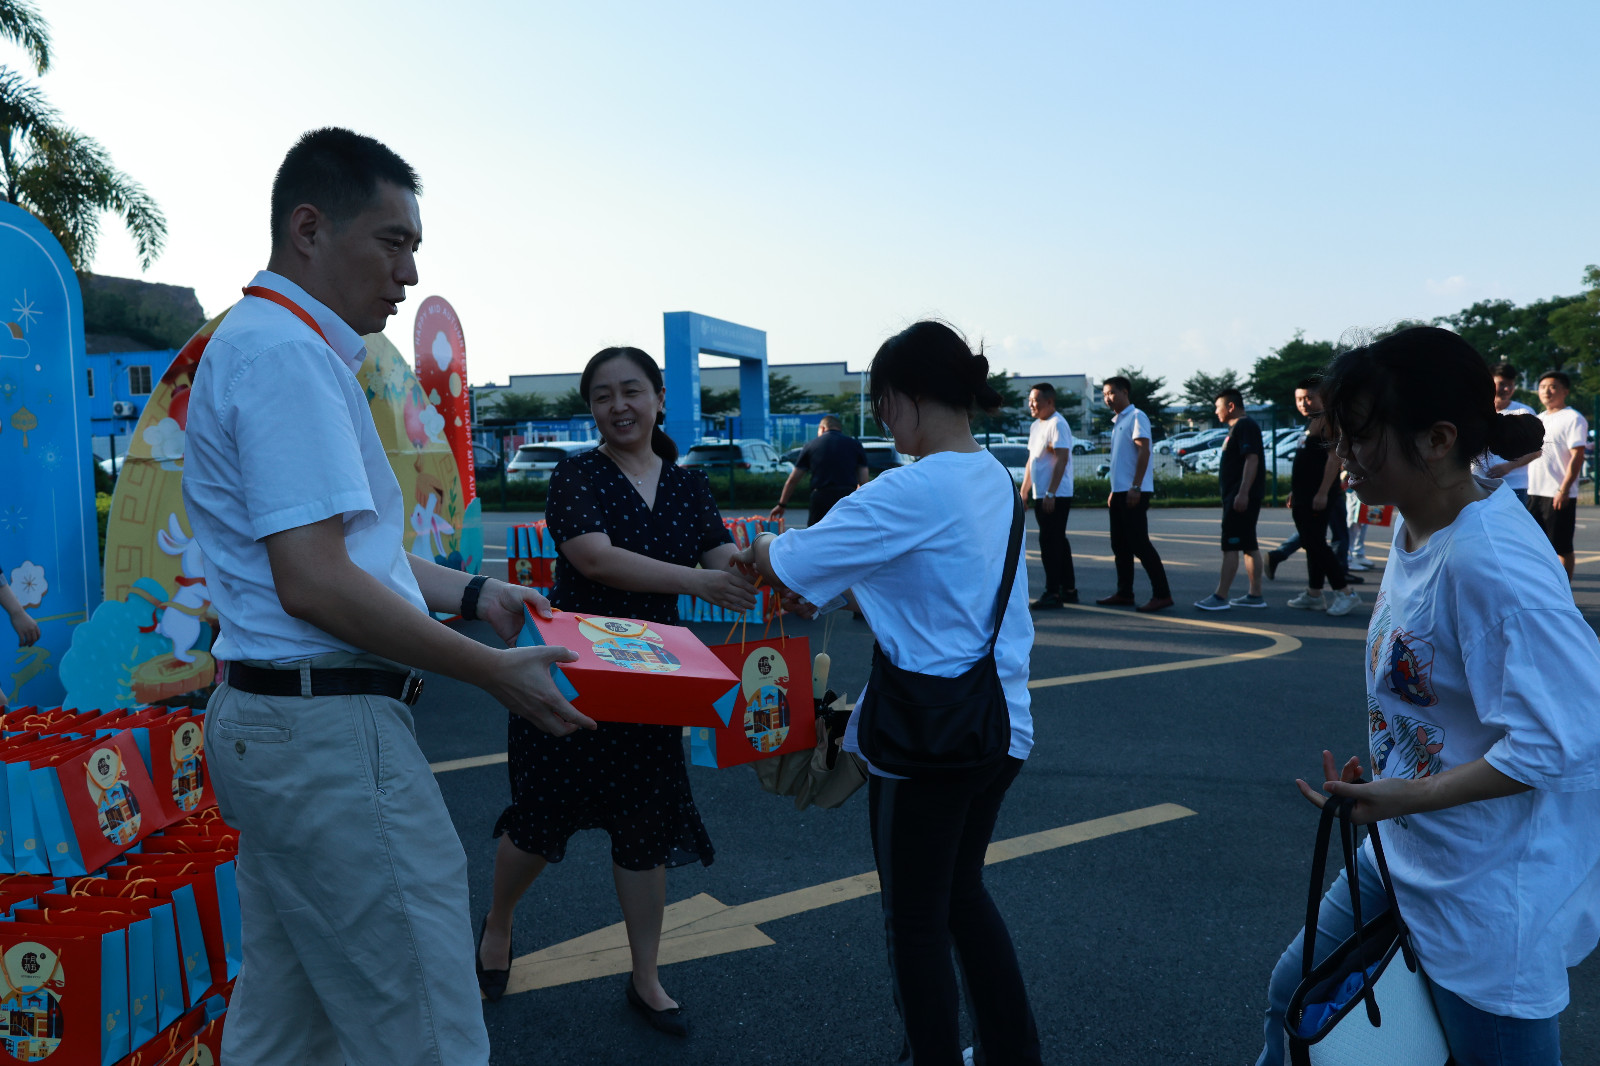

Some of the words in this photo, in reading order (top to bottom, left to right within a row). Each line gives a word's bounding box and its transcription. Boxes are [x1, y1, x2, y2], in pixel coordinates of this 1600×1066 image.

[415, 311, 427, 345] HAPPY
[428, 304, 441, 315] MID
[442, 308, 464, 347] AUTUMN
[461, 352, 469, 405] FESTIVAL
[464, 409, 473, 446] HAPPY
